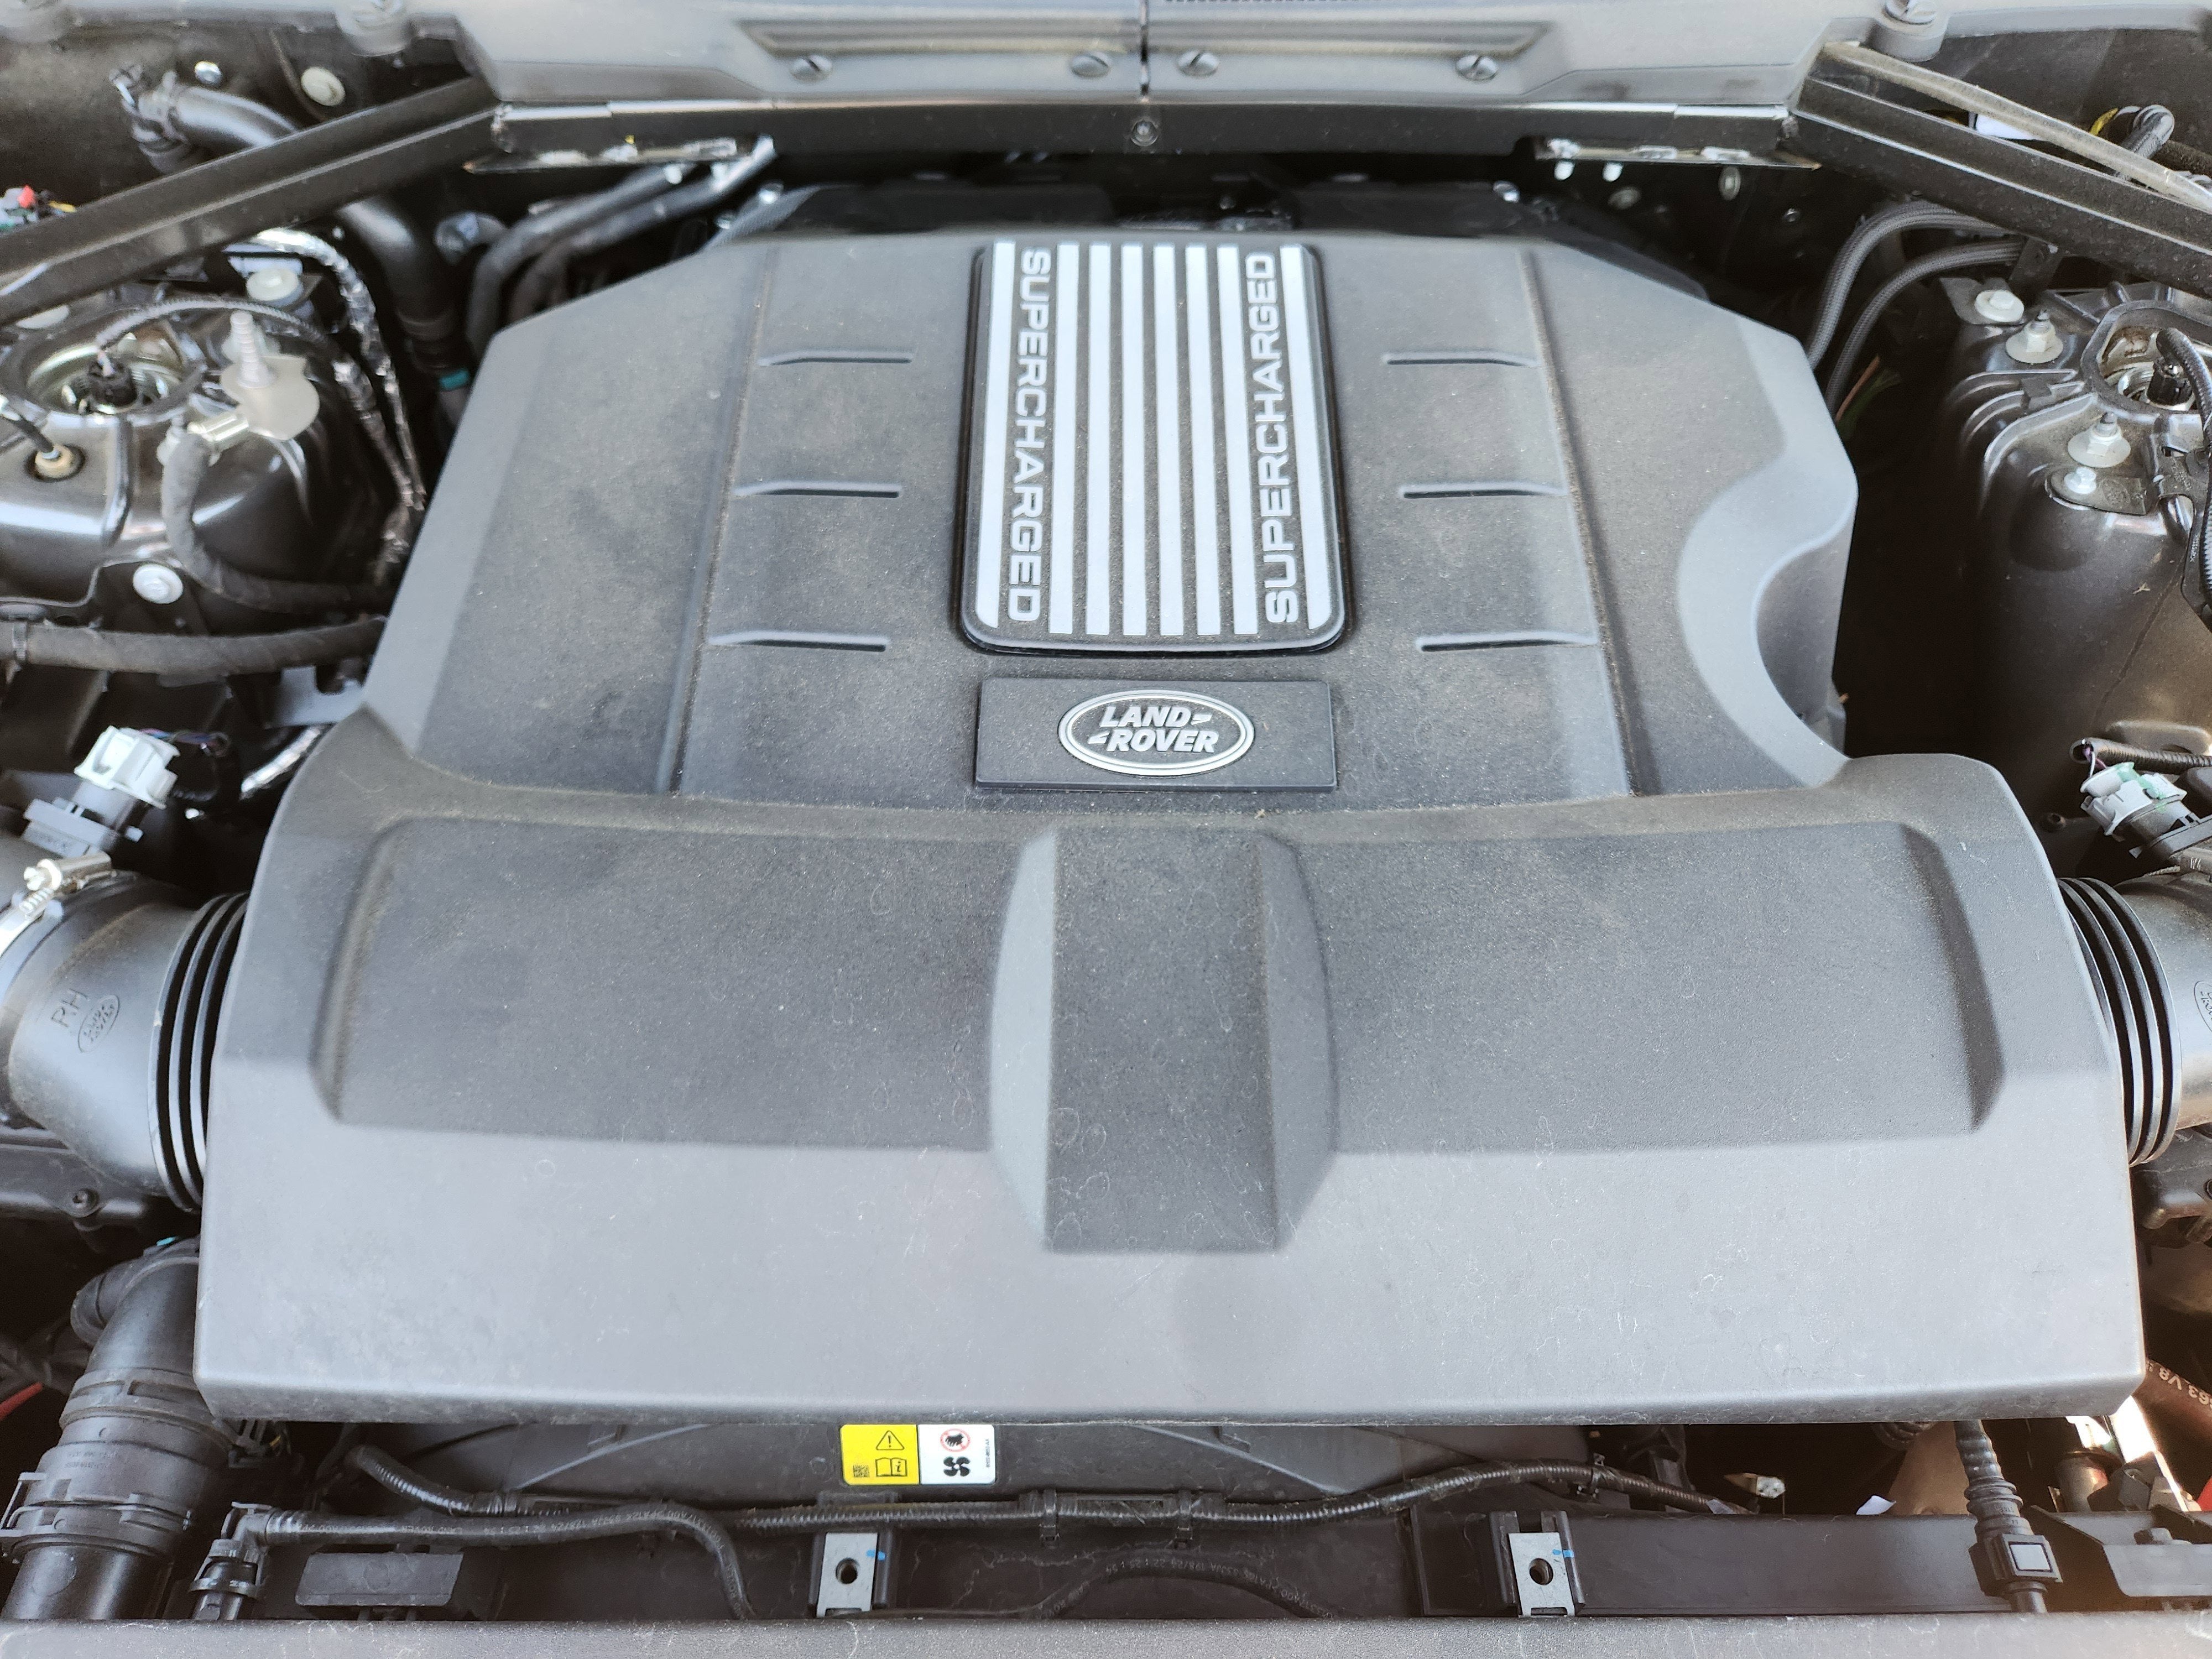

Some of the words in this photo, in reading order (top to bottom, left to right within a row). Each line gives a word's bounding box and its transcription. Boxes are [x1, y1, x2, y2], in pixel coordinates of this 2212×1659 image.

[1008, 247, 1051, 622] SUPERCHARGED
[1245, 251, 1299, 624] SUPERCHARGED
[1099, 705, 1192, 728] LAND
[1106, 728, 1219, 754] ROVER
[50, 988, 89, 1027] RH
[2159, 1367, 2182, 1391] V8
